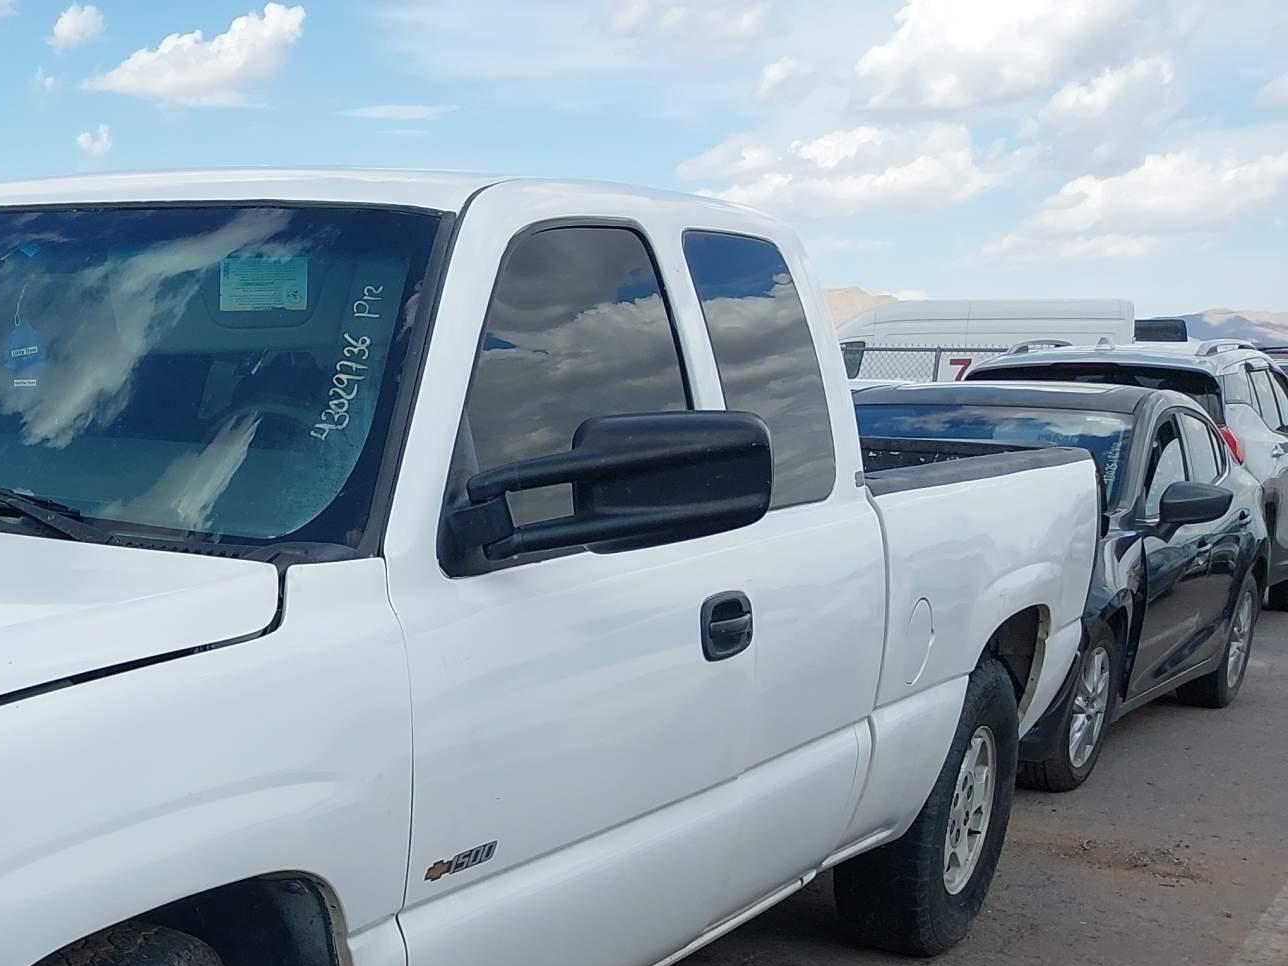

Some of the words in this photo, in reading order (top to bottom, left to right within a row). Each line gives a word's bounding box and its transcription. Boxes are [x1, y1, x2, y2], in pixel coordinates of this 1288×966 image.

[310, 333, 371, 440] 43029736
[949, 358, 972, 381] 7
[449, 840, 498, 875] 1500
